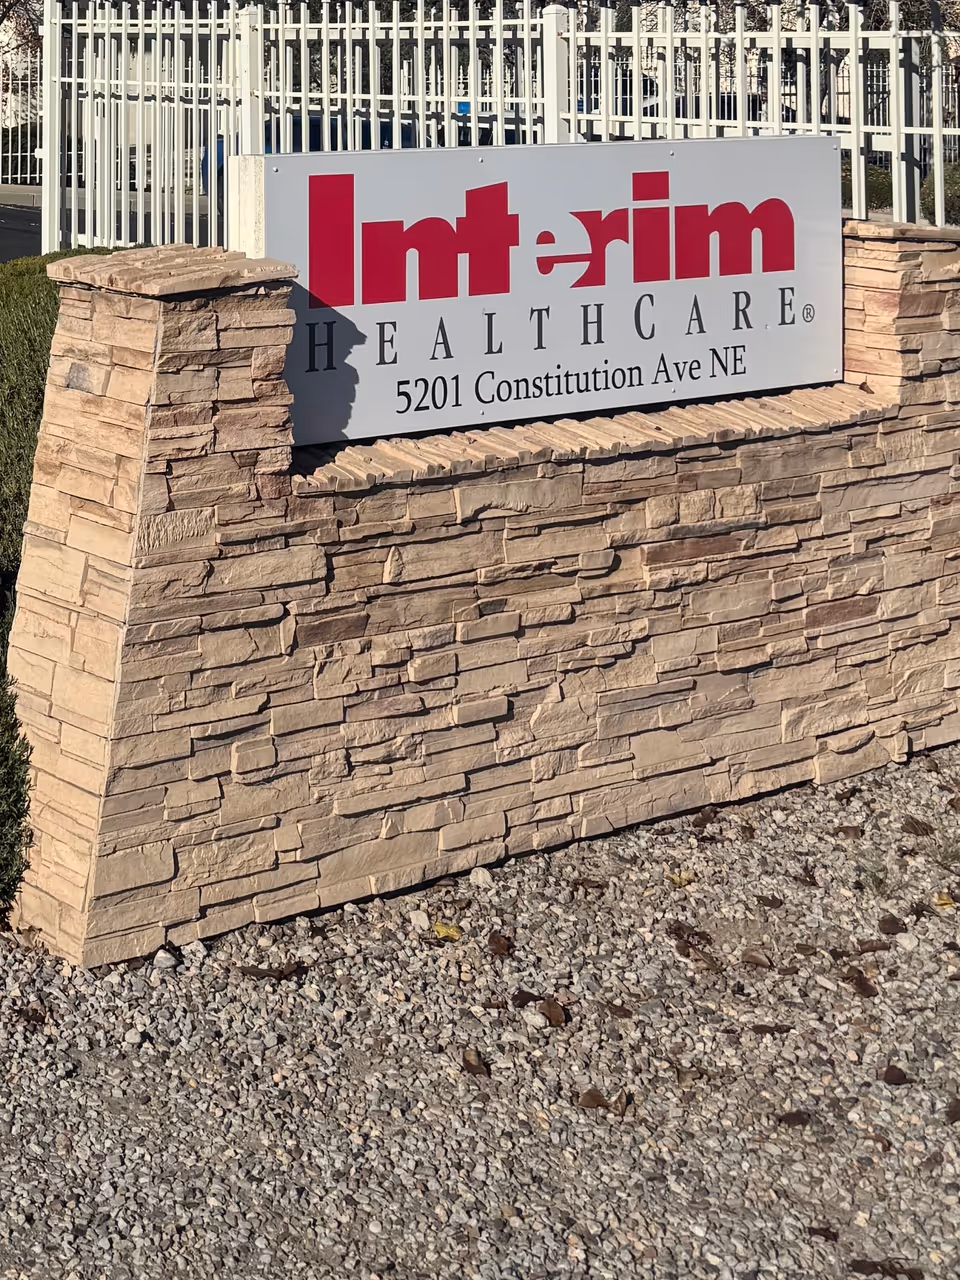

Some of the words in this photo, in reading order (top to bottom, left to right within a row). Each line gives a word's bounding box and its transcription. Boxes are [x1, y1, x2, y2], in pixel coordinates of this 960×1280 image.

[309, 172, 795, 309] Interim
[396, 374, 463, 414] 5201
[474, 358, 643, 404] Constitution
[651, 351, 702, 385] Ave
[709, 344, 746, 377] NE
